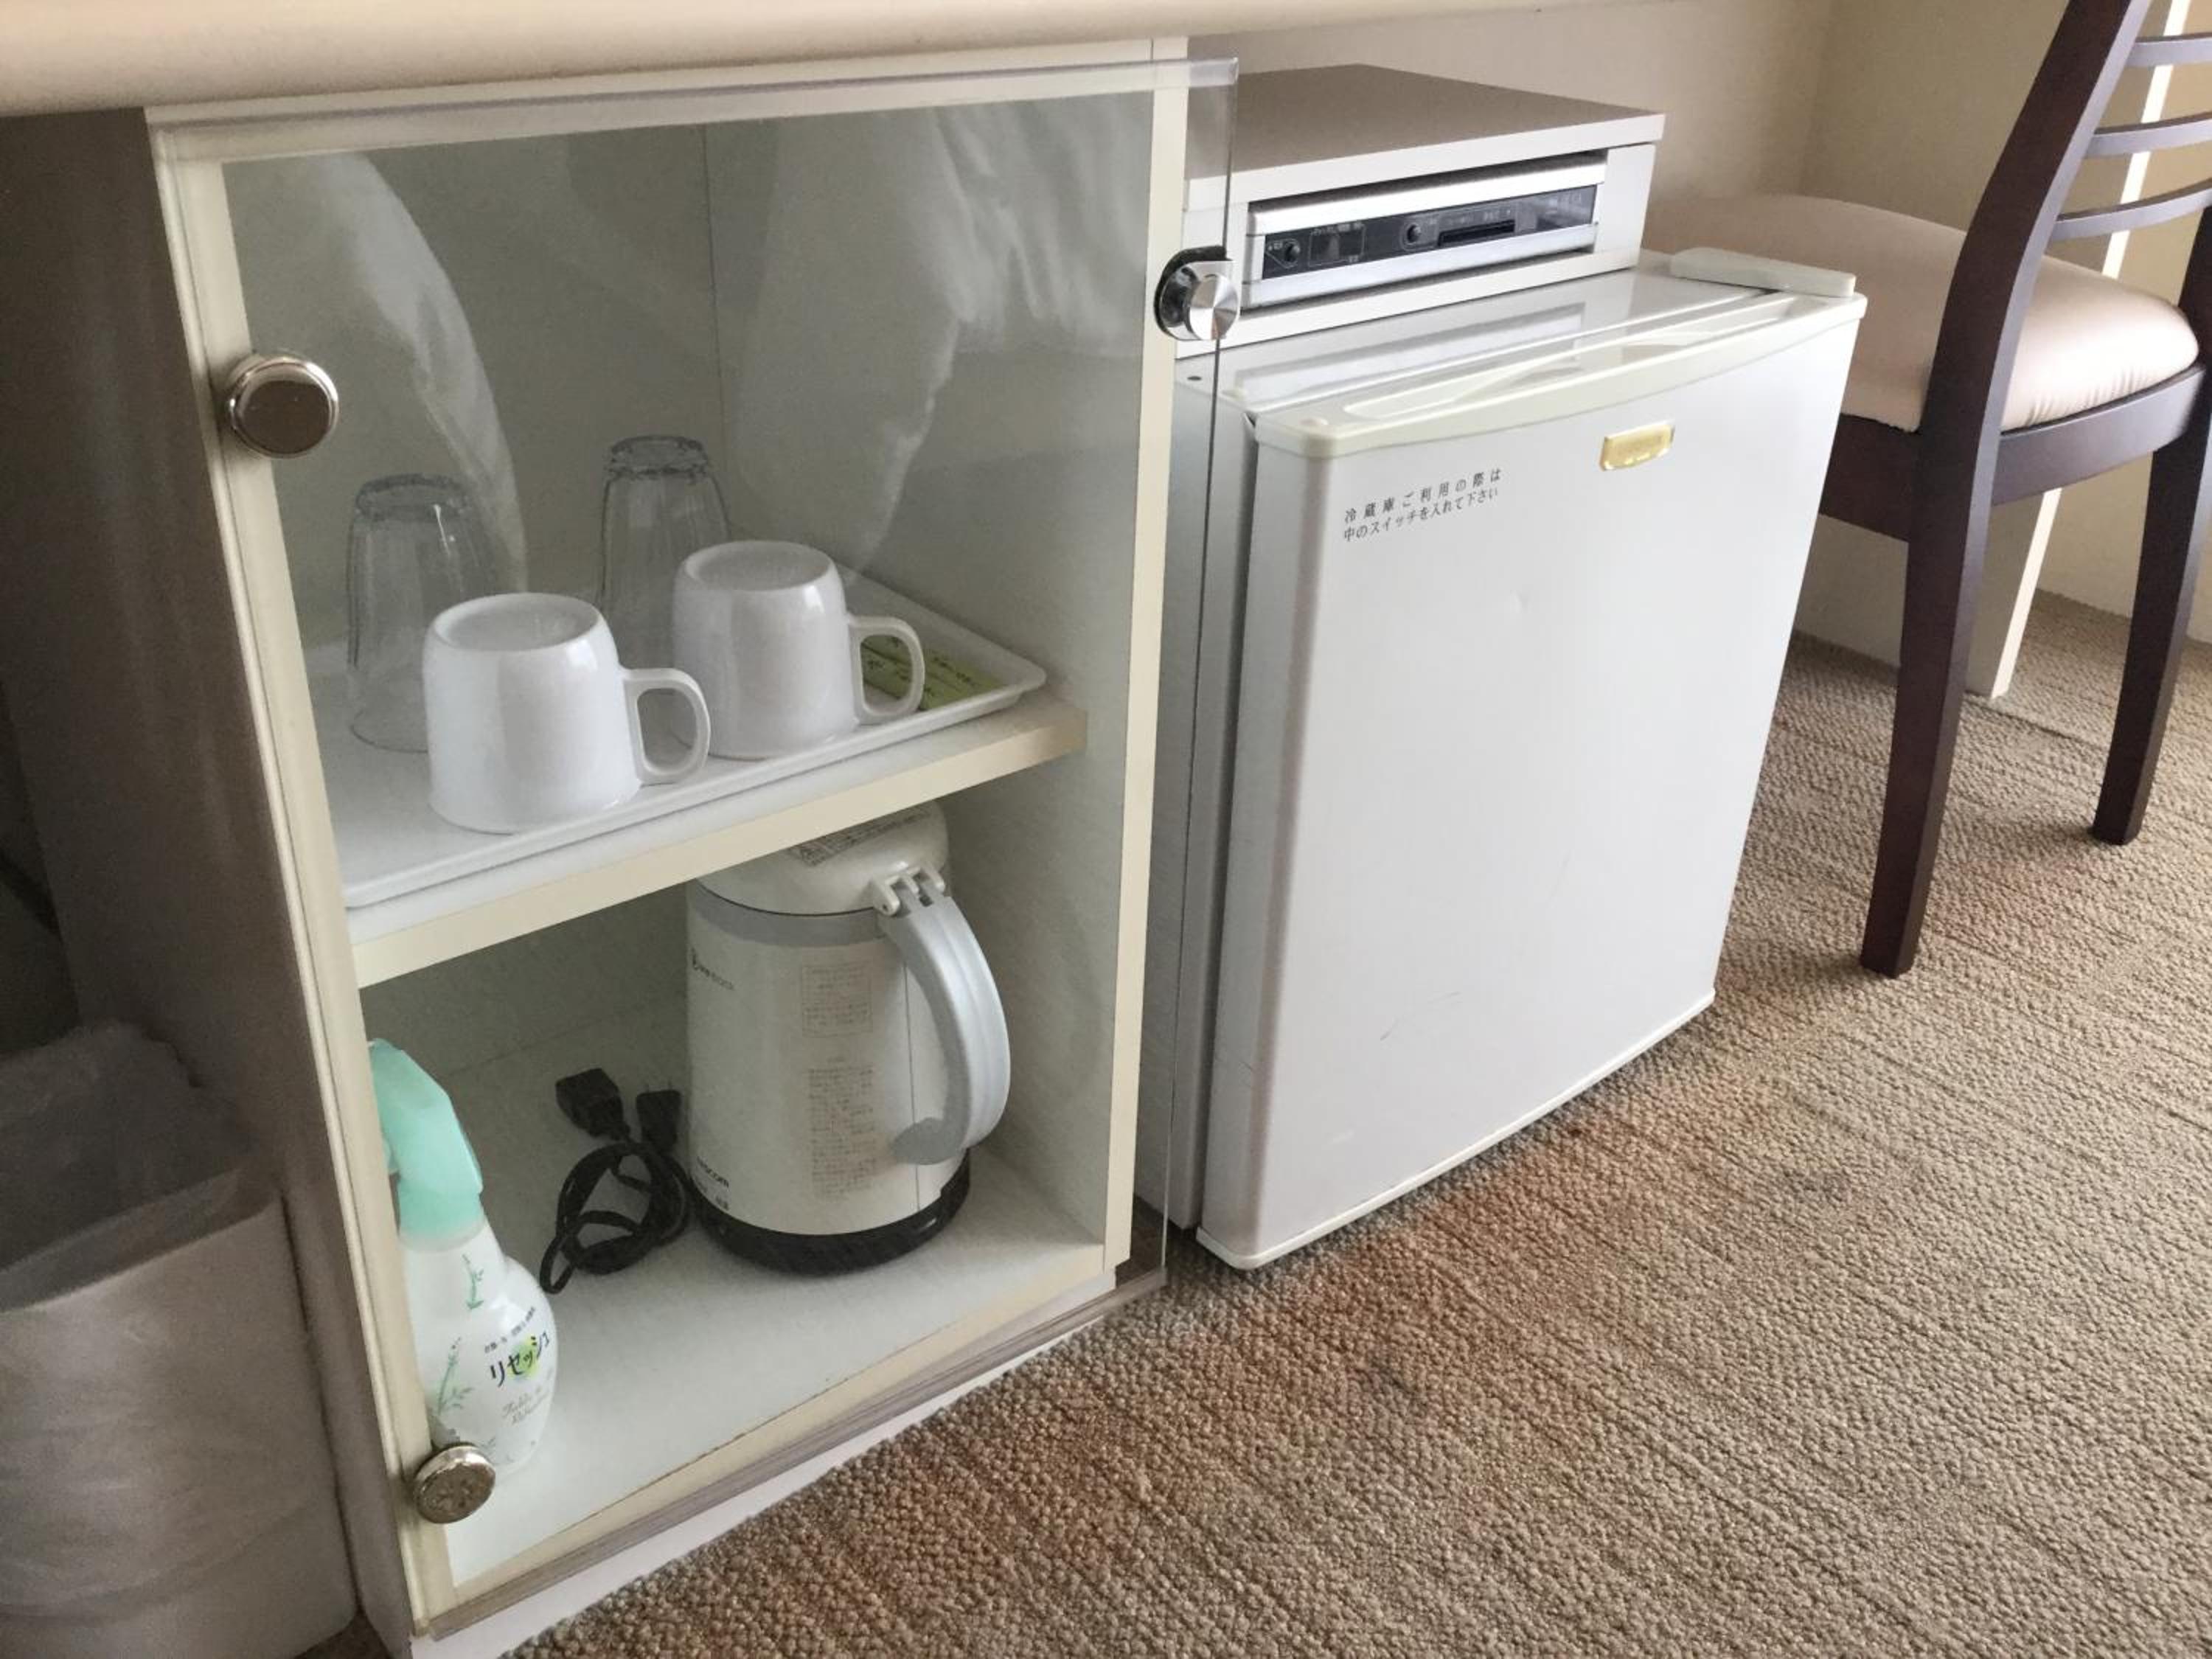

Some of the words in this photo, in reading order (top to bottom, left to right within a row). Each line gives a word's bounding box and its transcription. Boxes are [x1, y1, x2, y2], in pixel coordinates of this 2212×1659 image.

[1343, 487, 1499, 542] 中のスイッチを入れて下さい
[1344, 468, 1502, 524] 冷蔵庫ご利用の際は
